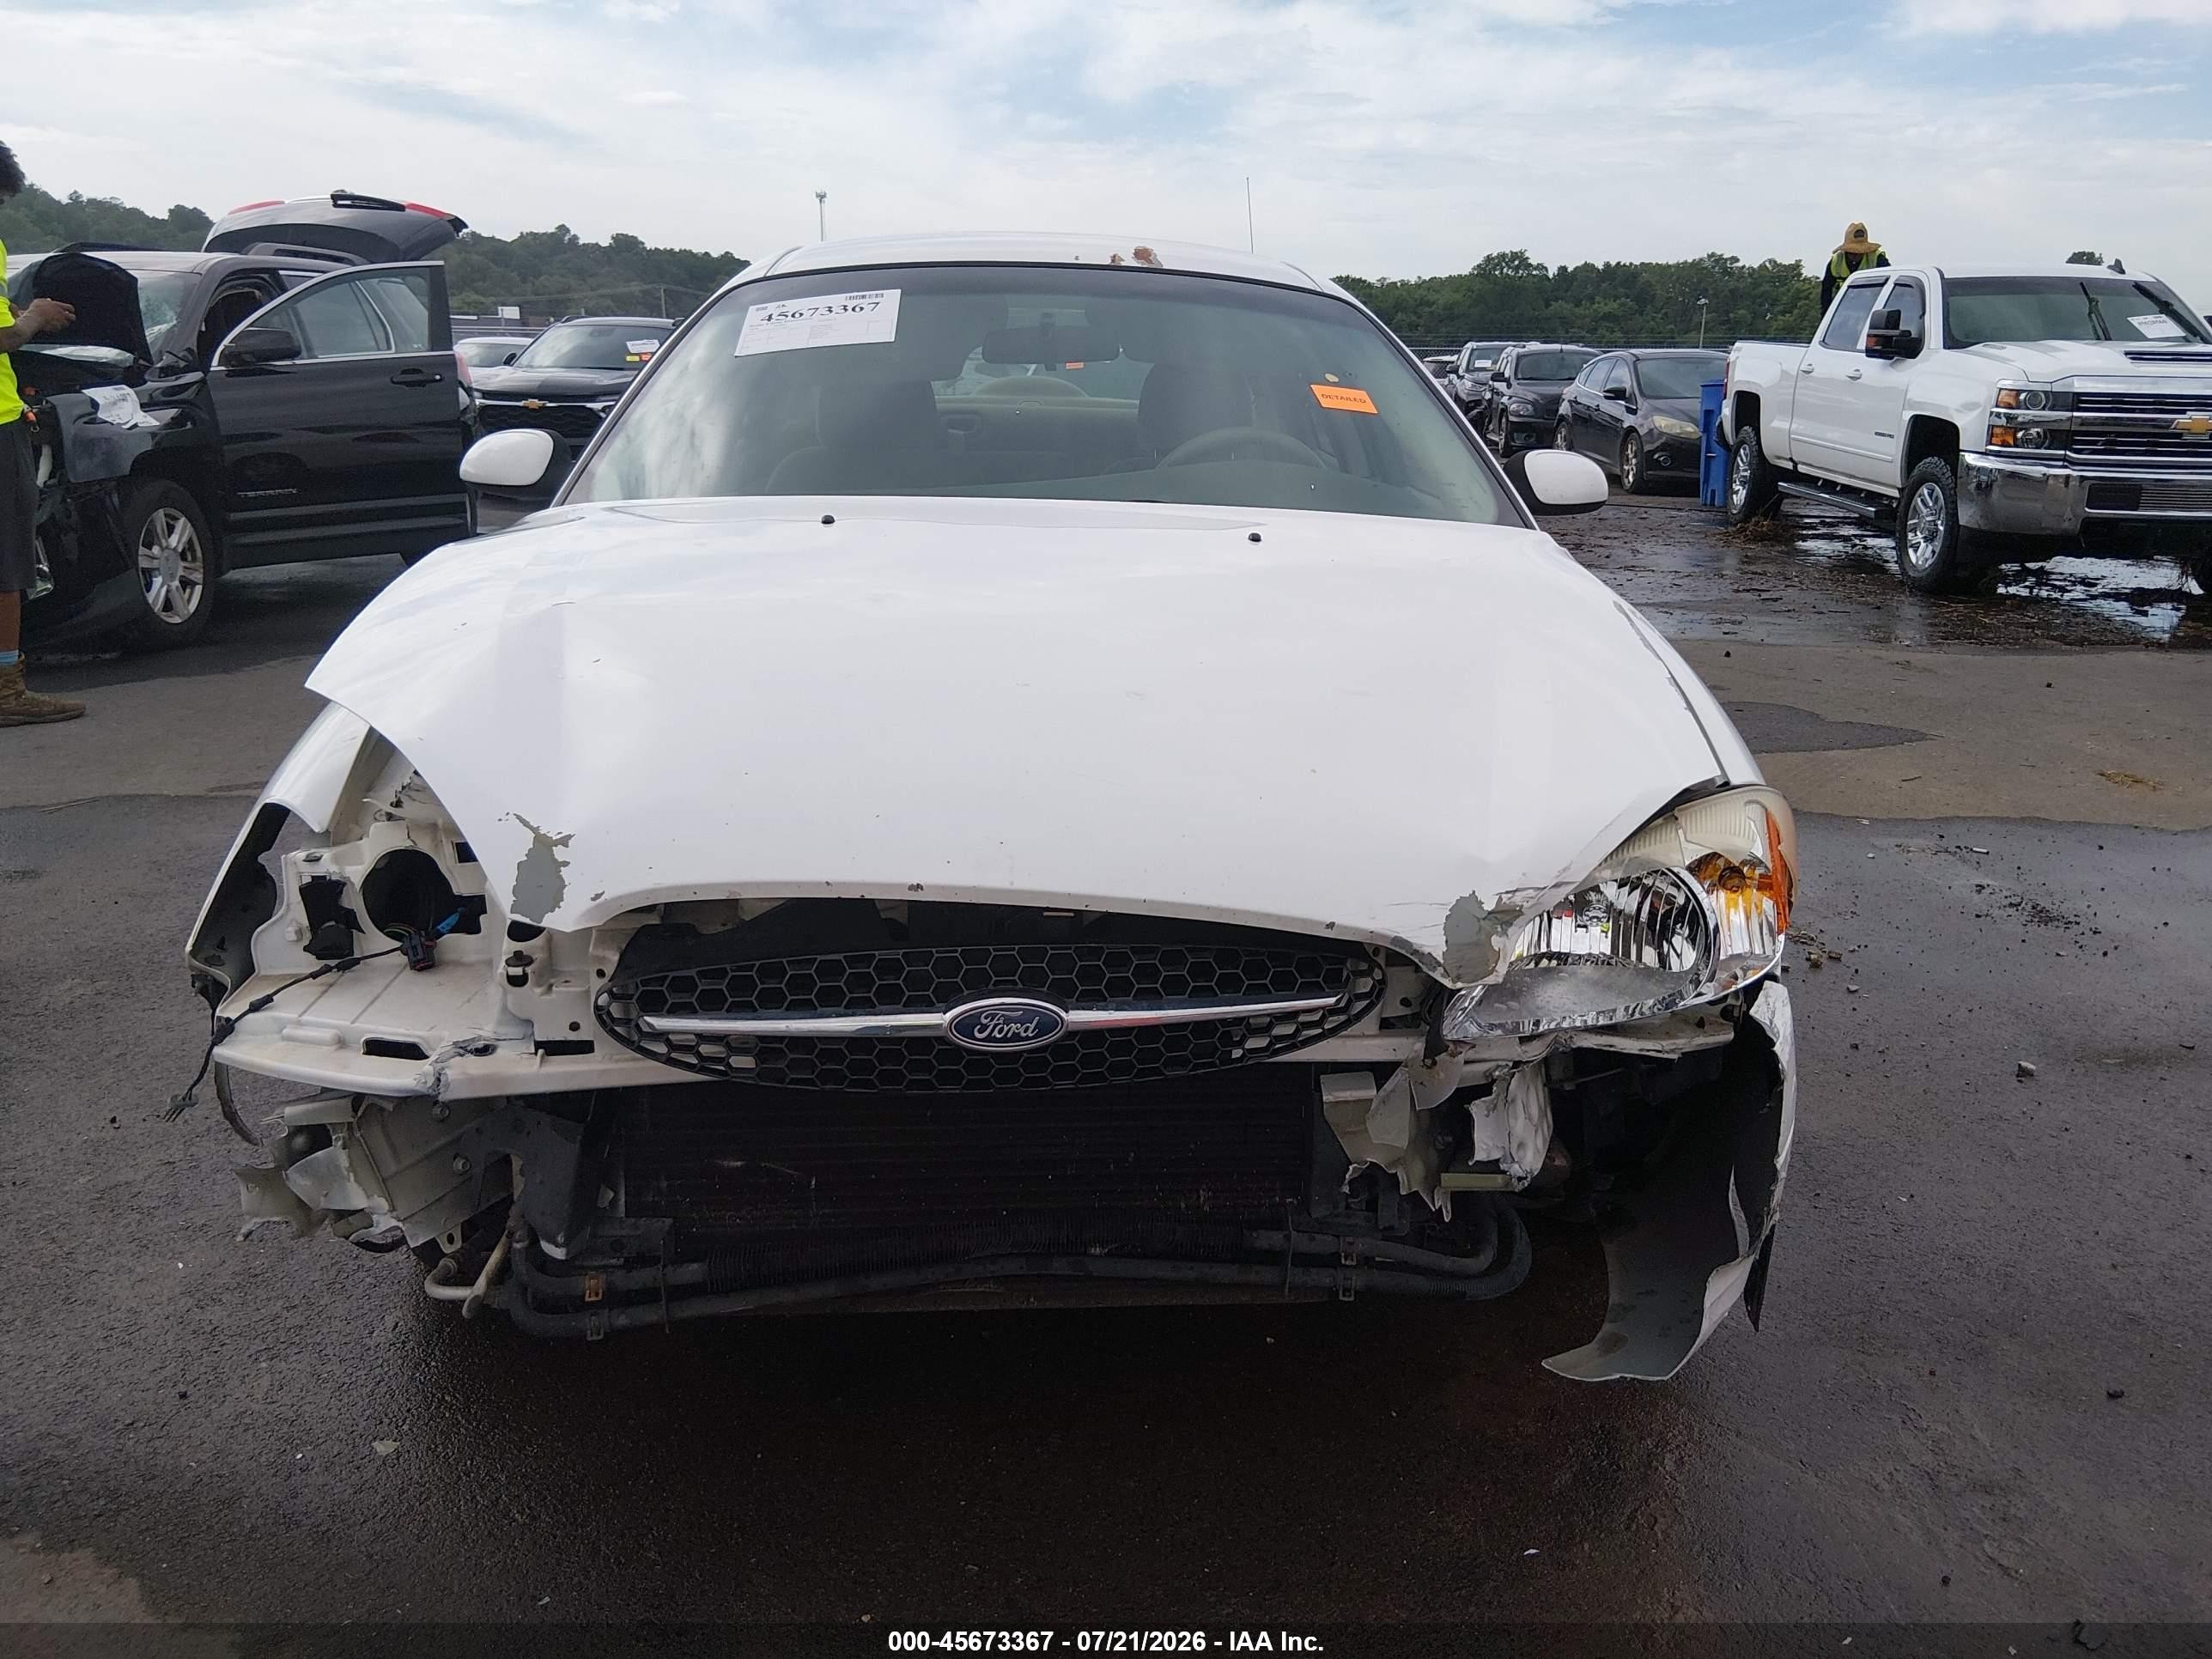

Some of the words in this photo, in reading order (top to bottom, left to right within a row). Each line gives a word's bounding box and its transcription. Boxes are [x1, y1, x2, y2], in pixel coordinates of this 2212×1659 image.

[761, 302, 880, 322] 45673367
[1322, 393, 1367, 404] DETAILED
[974, 1010, 1040, 1039] Ford
